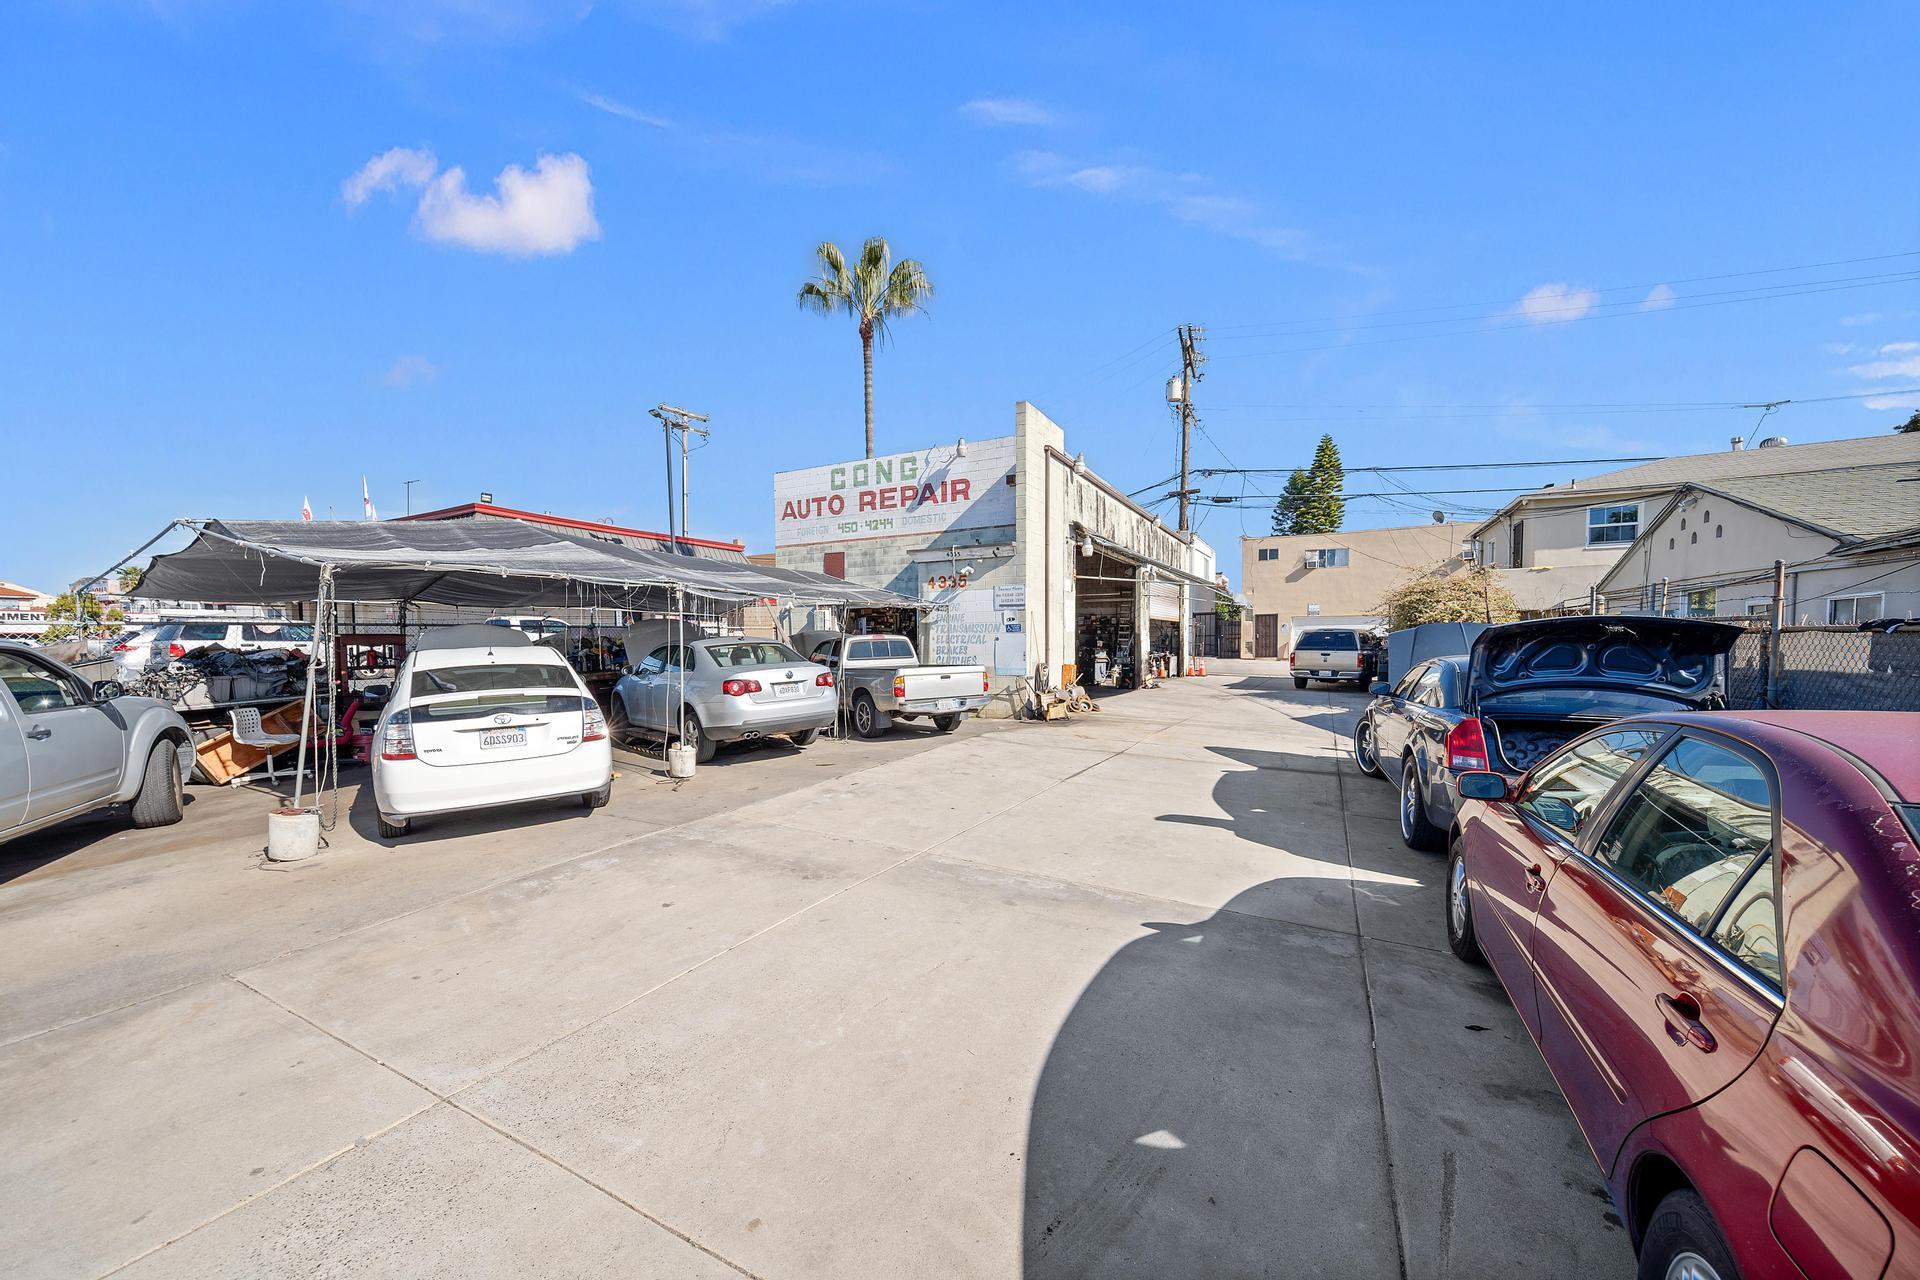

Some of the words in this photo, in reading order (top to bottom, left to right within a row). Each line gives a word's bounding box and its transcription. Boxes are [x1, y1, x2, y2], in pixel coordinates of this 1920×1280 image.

[831, 456, 918, 491] CONG
[782, 494, 845, 520] AUTO
[859, 479, 970, 512] REPAIR
[797, 526, 829, 537] FOREIGN
[902, 513, 947, 526] DOMESTIC
[928, 574, 967, 589] 4335
[936, 635, 987, 645] ELECTRICAL
[936, 646, 968, 655] BRAKES
[483, 733, 524, 746] 6DSS903
